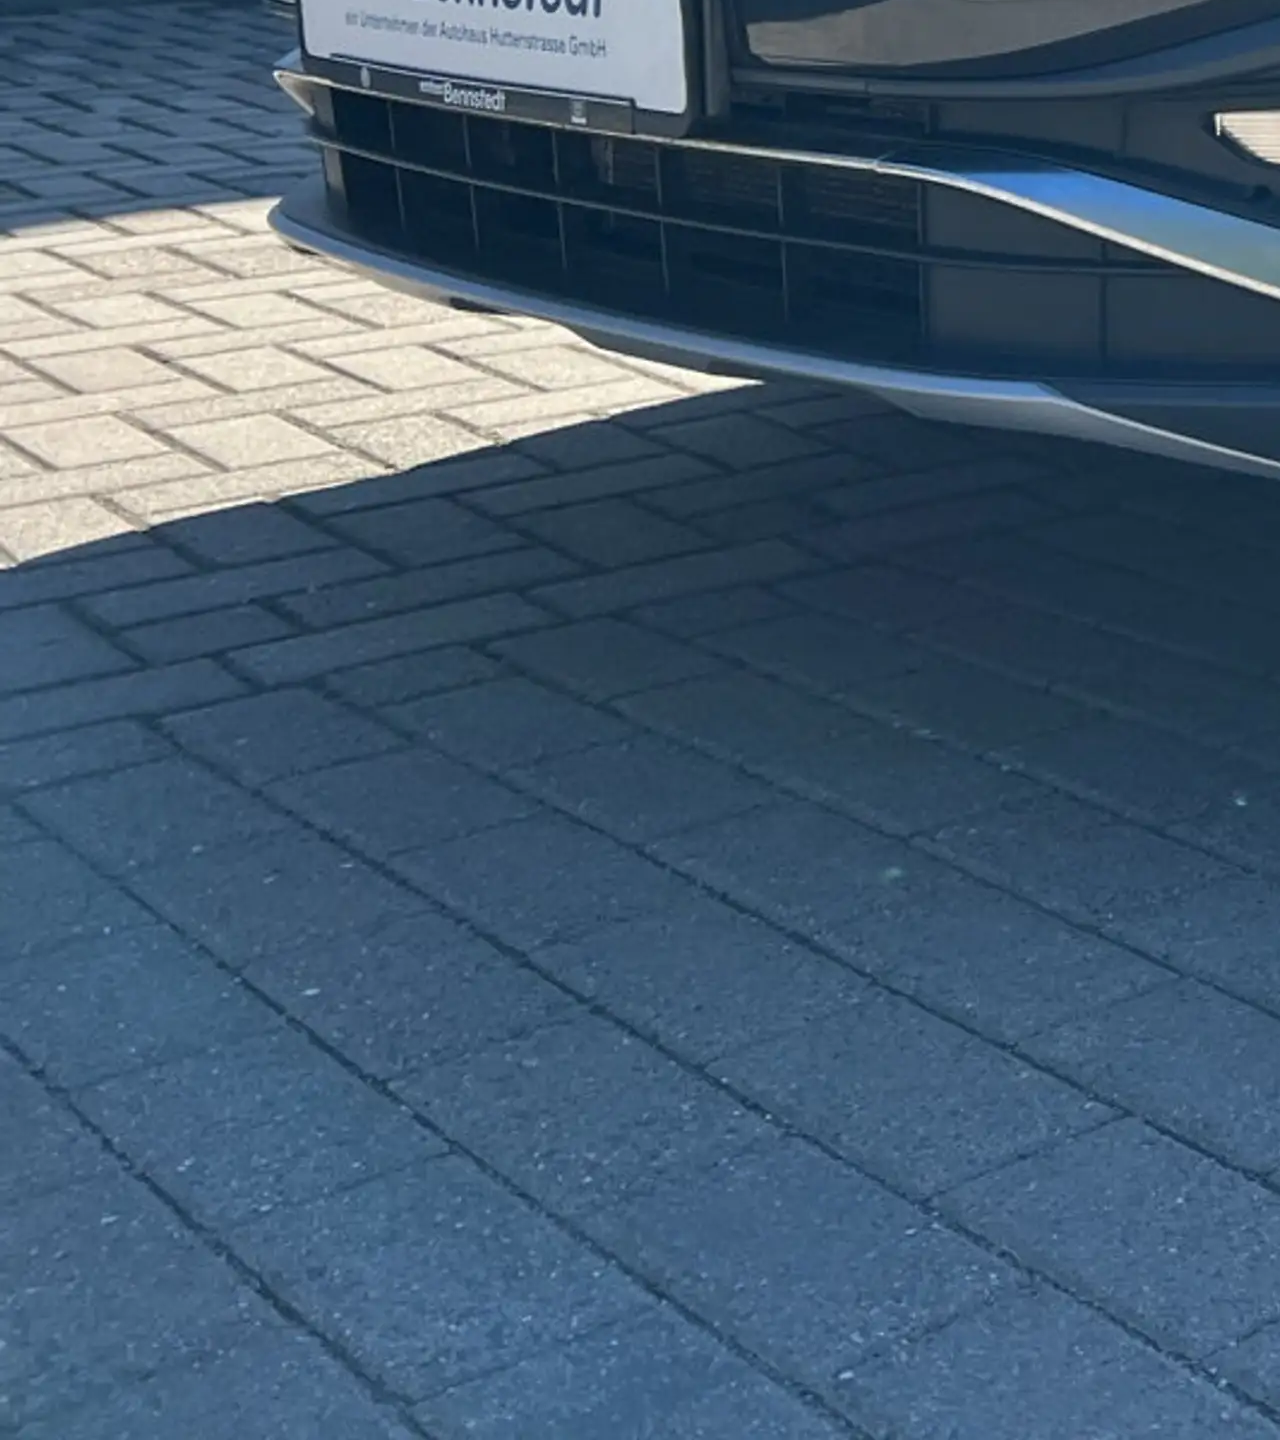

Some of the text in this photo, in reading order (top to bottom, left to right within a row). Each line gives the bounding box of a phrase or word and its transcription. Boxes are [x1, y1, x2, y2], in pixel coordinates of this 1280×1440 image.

[440, 20, 488, 45] Autohaus
[568, 34, 607, 58] GmbH
[443, 81, 506, 111] Bennstedt
